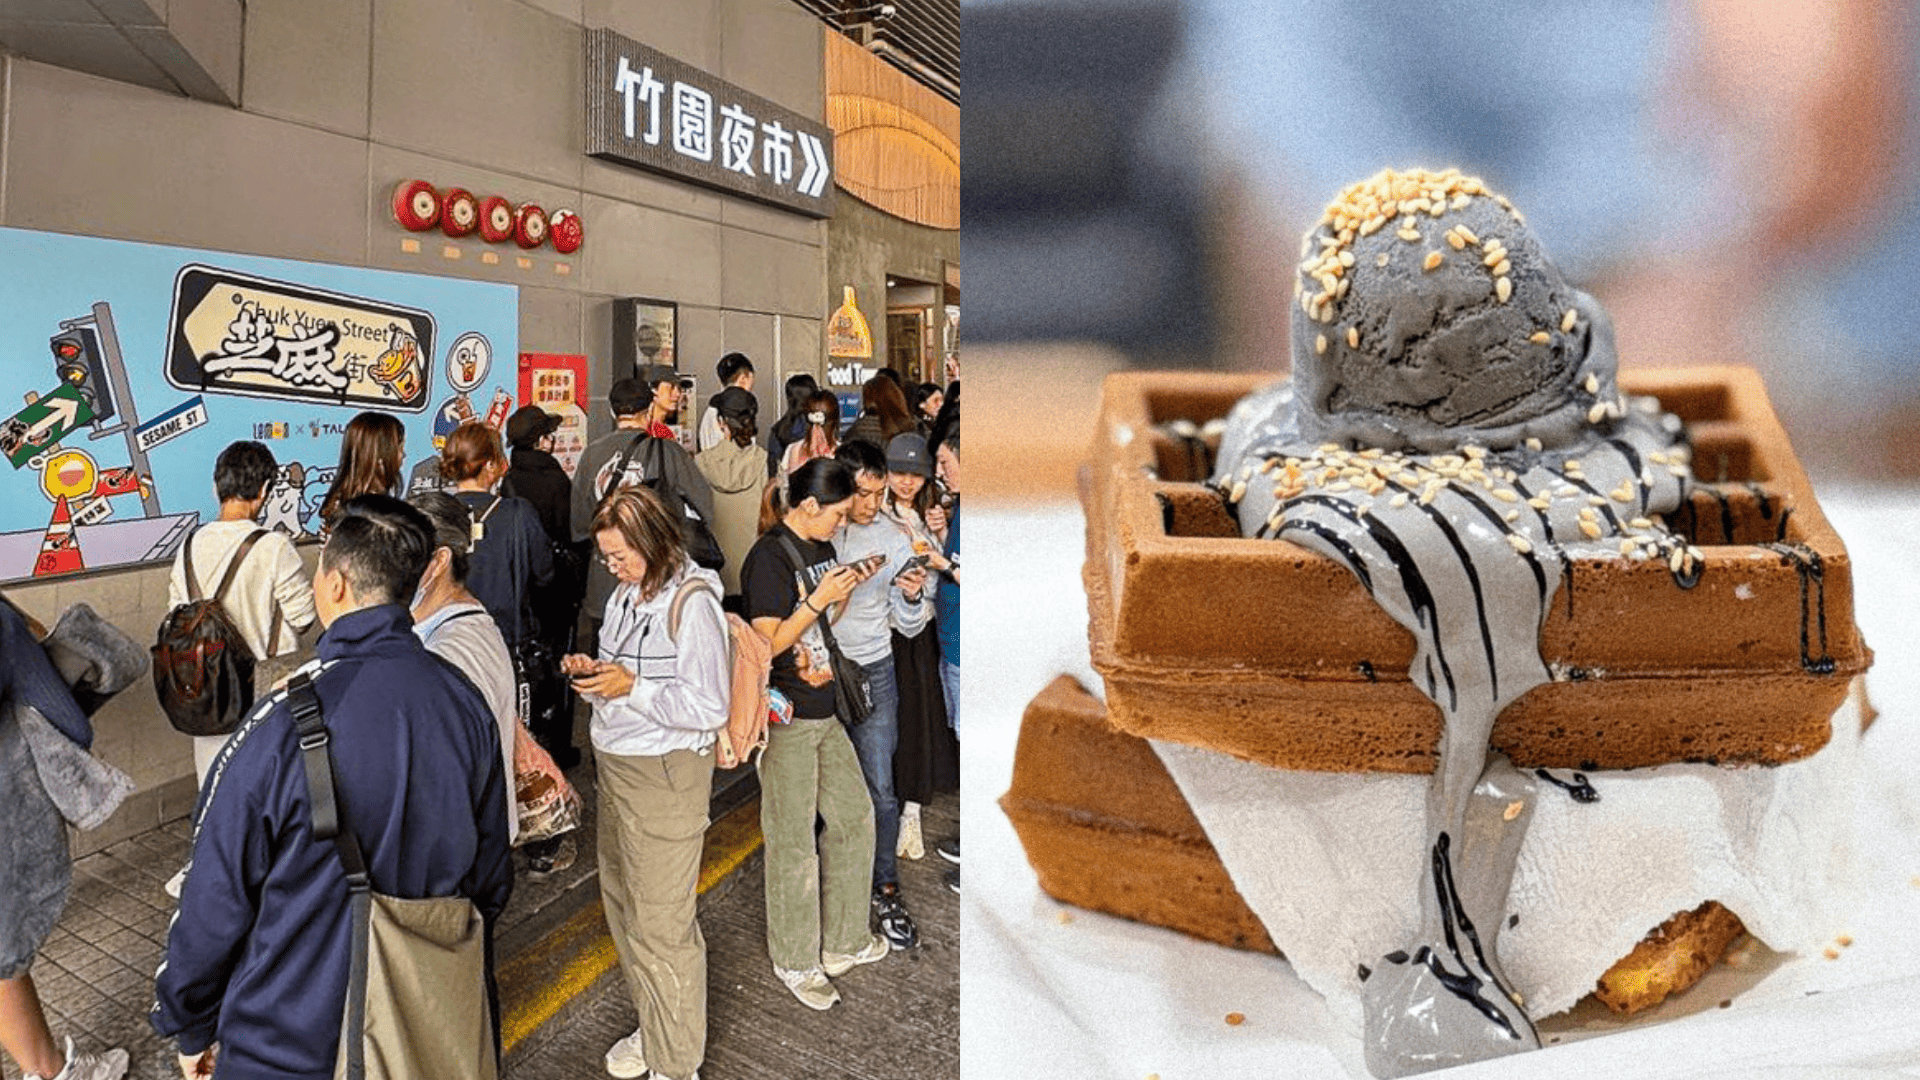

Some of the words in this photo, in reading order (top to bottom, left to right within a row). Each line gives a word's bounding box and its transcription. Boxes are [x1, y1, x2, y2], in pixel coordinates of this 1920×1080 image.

[614, 56, 794, 185] 竹園夜市
[342, 318, 389, 343] Street
[142, 417, 182, 446] SESAME
[186, 410, 198, 426] ST
